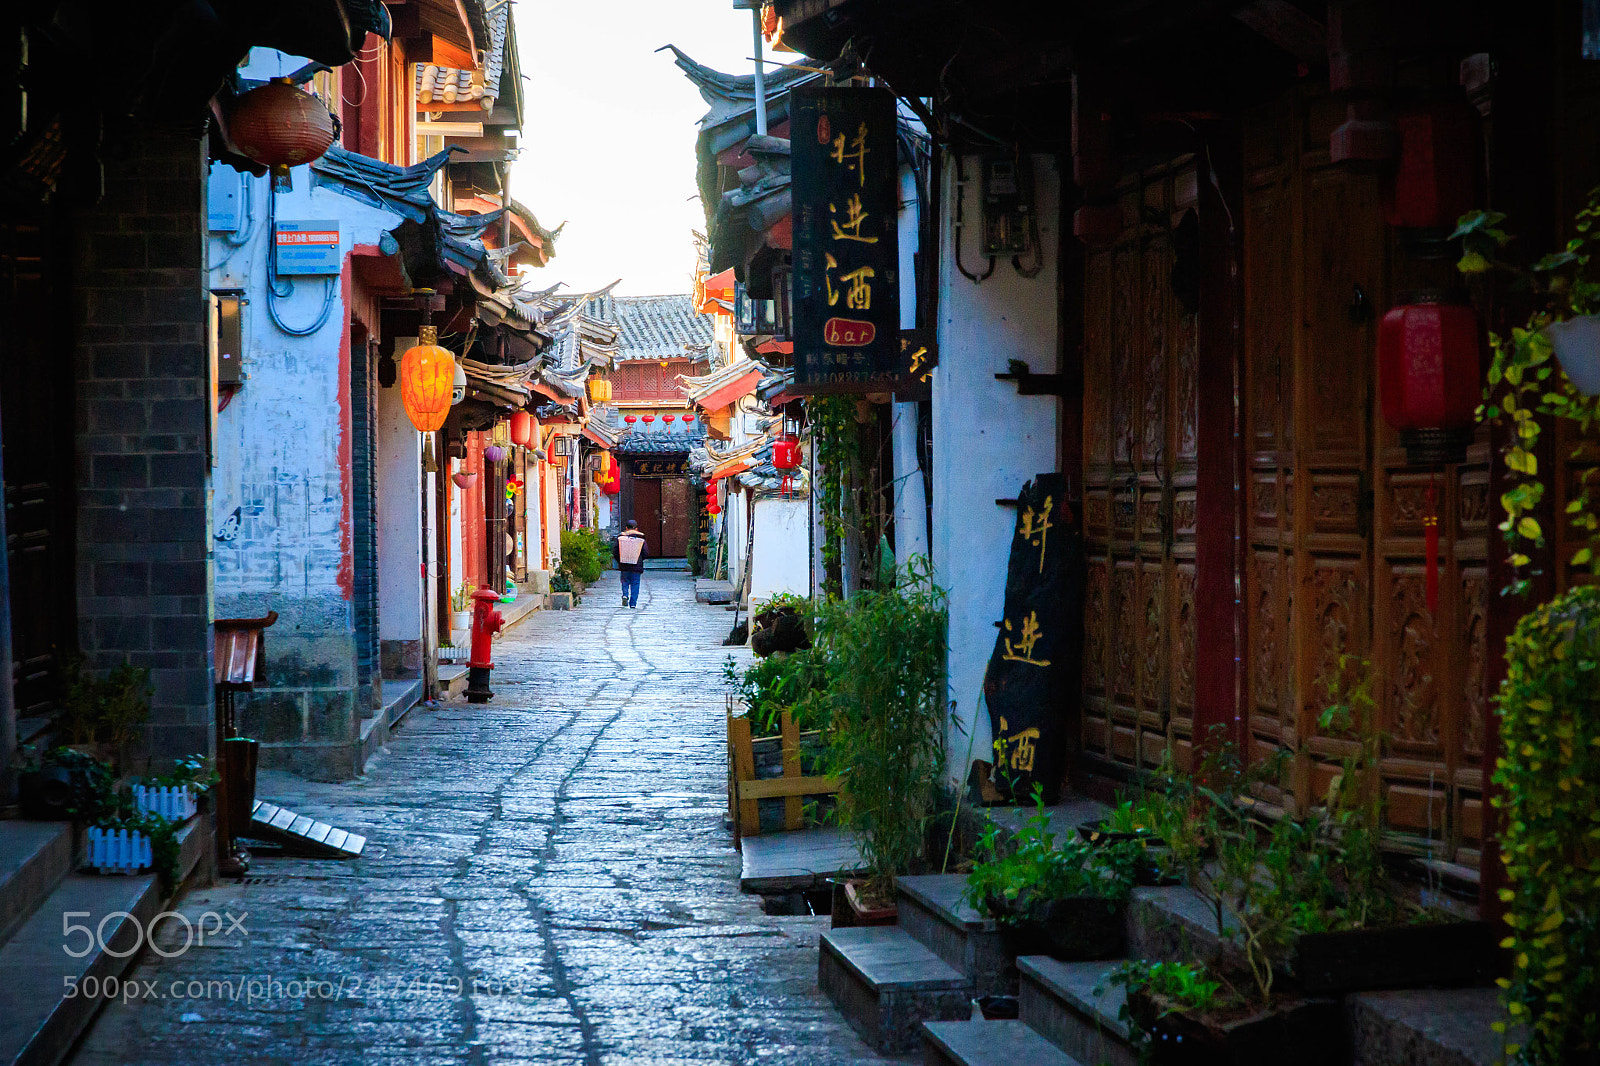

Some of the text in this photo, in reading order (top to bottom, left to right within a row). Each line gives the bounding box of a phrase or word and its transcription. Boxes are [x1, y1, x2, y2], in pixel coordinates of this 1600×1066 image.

[826, 121, 878, 310] 将进酒
[830, 324, 868, 344] bar
